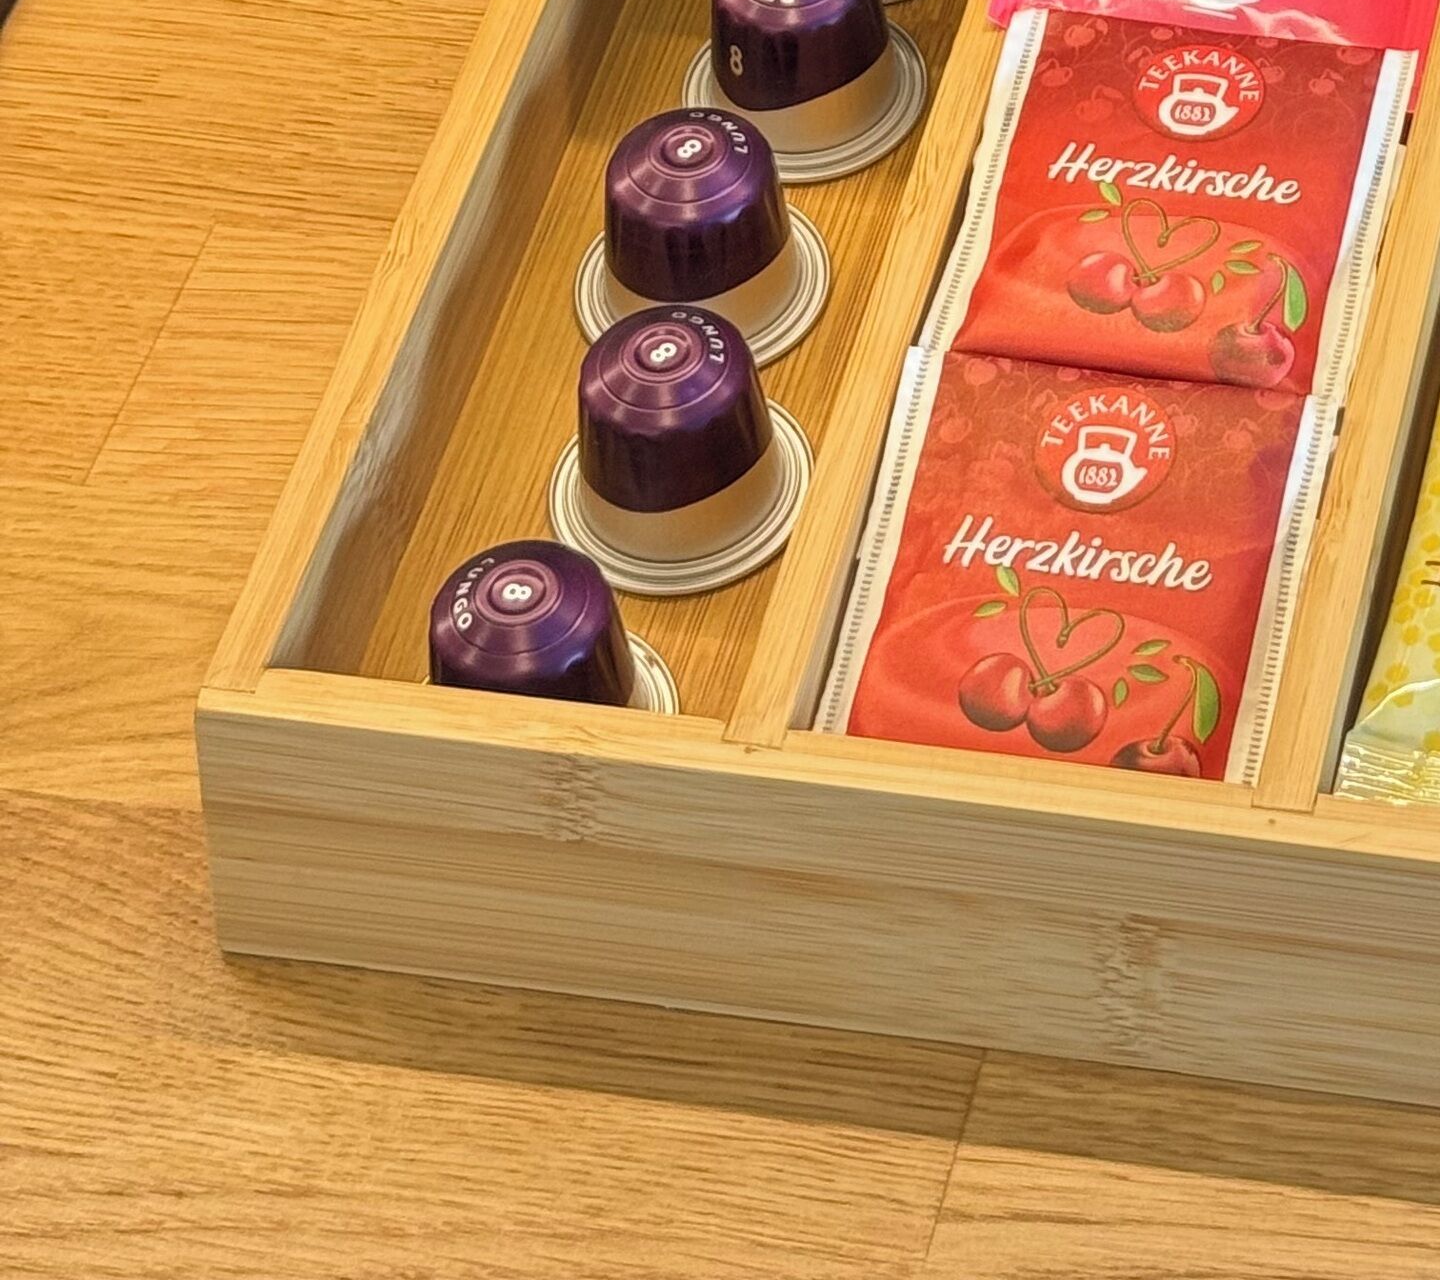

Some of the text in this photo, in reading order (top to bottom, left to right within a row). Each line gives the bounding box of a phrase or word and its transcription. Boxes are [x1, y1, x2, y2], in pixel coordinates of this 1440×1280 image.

[728, 43, 745, 77] 8
[1136, 48, 1262, 106] TEEKANNE
[674, 136, 704, 161] 8
[688, 109, 750, 156] LUNGO
[1046, 140, 1304, 205] Herzkirsche
[648, 340, 678, 365] 8
[670, 310, 727, 365] LUNGO
[1039, 390, 1172, 463] TEEKANNE
[1076, 462, 1121, 489] 1882
[942, 512, 1214, 593] Herzkirsche
[502, 582, 534, 602] 8
